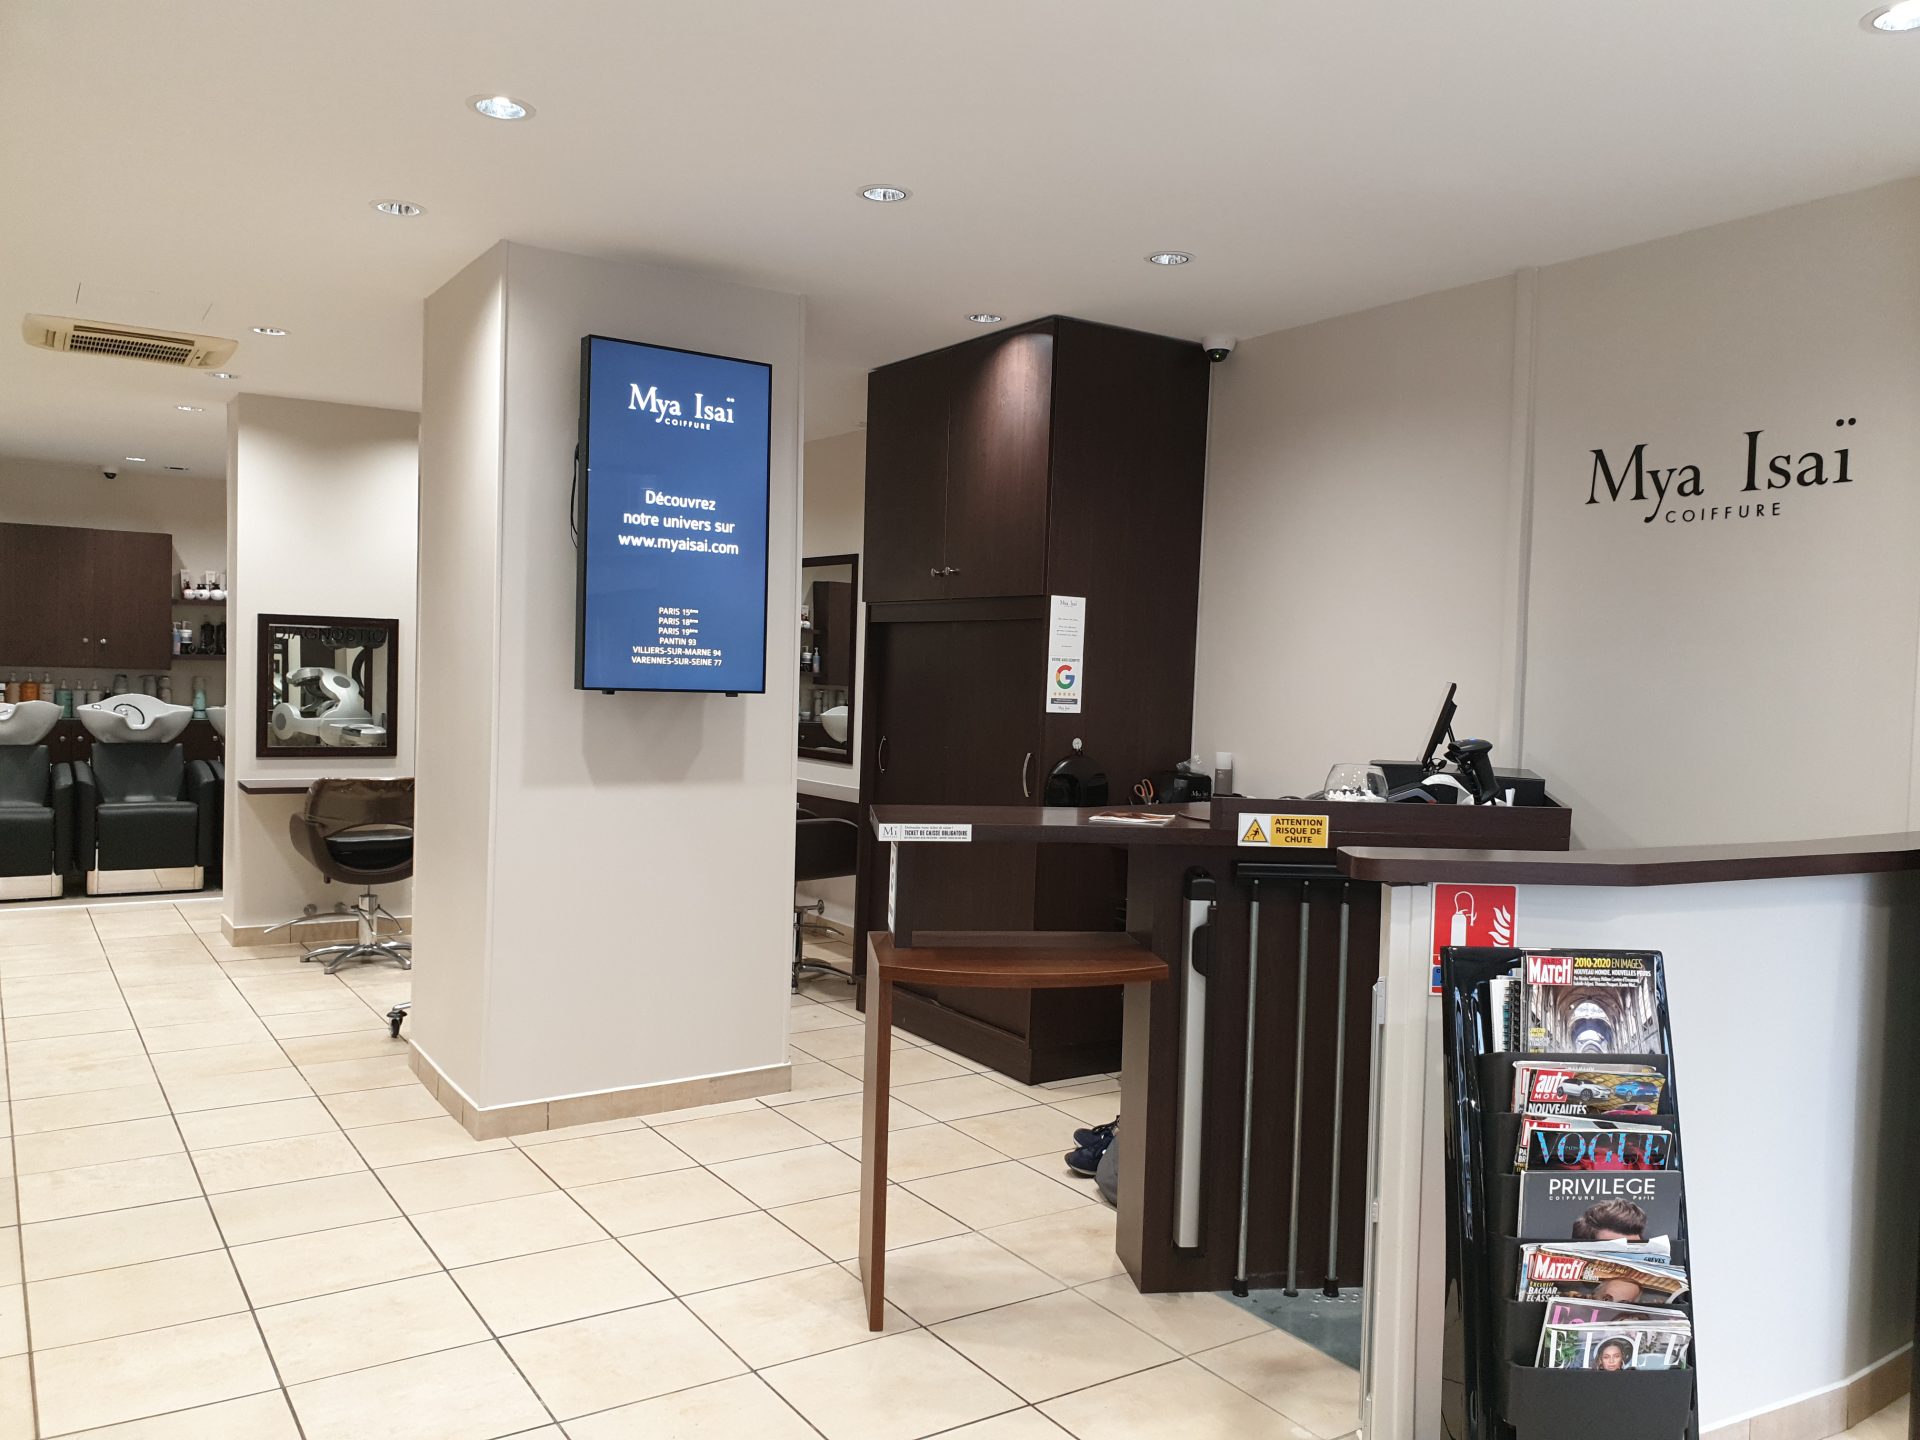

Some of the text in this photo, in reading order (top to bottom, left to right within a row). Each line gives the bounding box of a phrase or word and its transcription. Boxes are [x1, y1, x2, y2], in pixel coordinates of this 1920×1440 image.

[628, 383, 735, 424] Mya Isaï
[664, 418, 711, 431] COIFFURE
[1585, 417, 1857, 523] Mya Isaï
[645, 490, 716, 511] Découvrez
[1666, 502, 1781, 523] COIFFURE
[623, 513, 736, 533] notre univers sur
[618, 534, 739, 555] www.myaisai.com
[658, 607, 681, 616] PARIS
[658, 617, 680, 625] PARIS
[658, 627, 680, 635] PARIS
[659, 637, 697, 646] PANTIN 93
[632, 646, 722, 657] VILLIERS-SUR-MARNE 94
[631, 656, 713, 666] VARENNES-SUR-SEINE
[1274, 818, 1323, 826] ATTENTION
[1275, 827, 1309, 835] RISQUE
[1574, 957, 1643, 969] 2010-2020 EN IMAGES
[1528, 1101, 1587, 1114] NOUVEAUTÉS
[1536, 1131, 1668, 1165] VOGUE
[1549, 1178, 1656, 1195] PRIVILEGE
[1528, 1286, 1558, 1295] BACHAR
